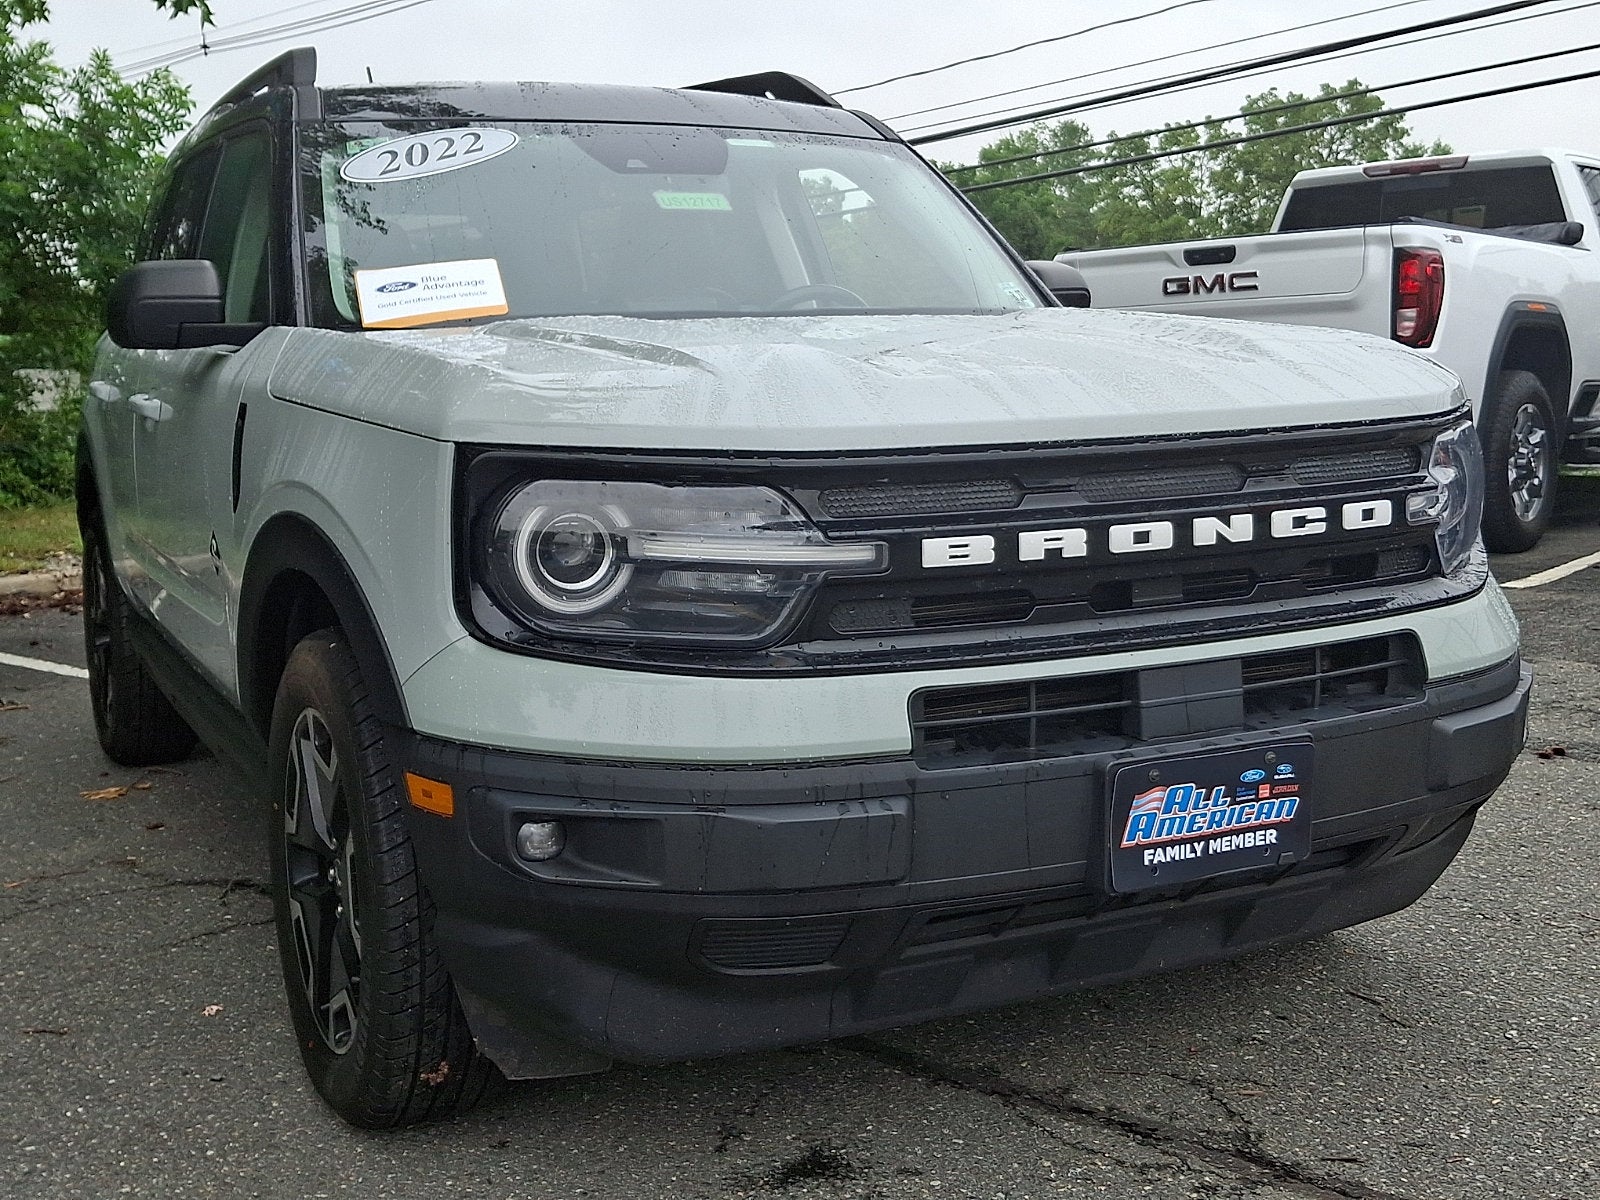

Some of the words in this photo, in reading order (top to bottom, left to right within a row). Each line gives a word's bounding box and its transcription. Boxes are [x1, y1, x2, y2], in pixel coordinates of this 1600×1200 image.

[376, 131, 484, 176] 2022
[421, 275, 447, 283] Blue
[422, 279, 485, 291] Advantage
[1162, 270, 1259, 295] GMC
[377, 300, 397, 309] Gold
[399, 296, 434, 305] Certified
[436, 293, 457, 301] Used
[459, 290, 488, 298] Vehicle
[921, 499, 1393, 569] BRONCO
[1143, 841, 1205, 866] FAMILY
[1208, 829, 1278, 855] MEMBER
